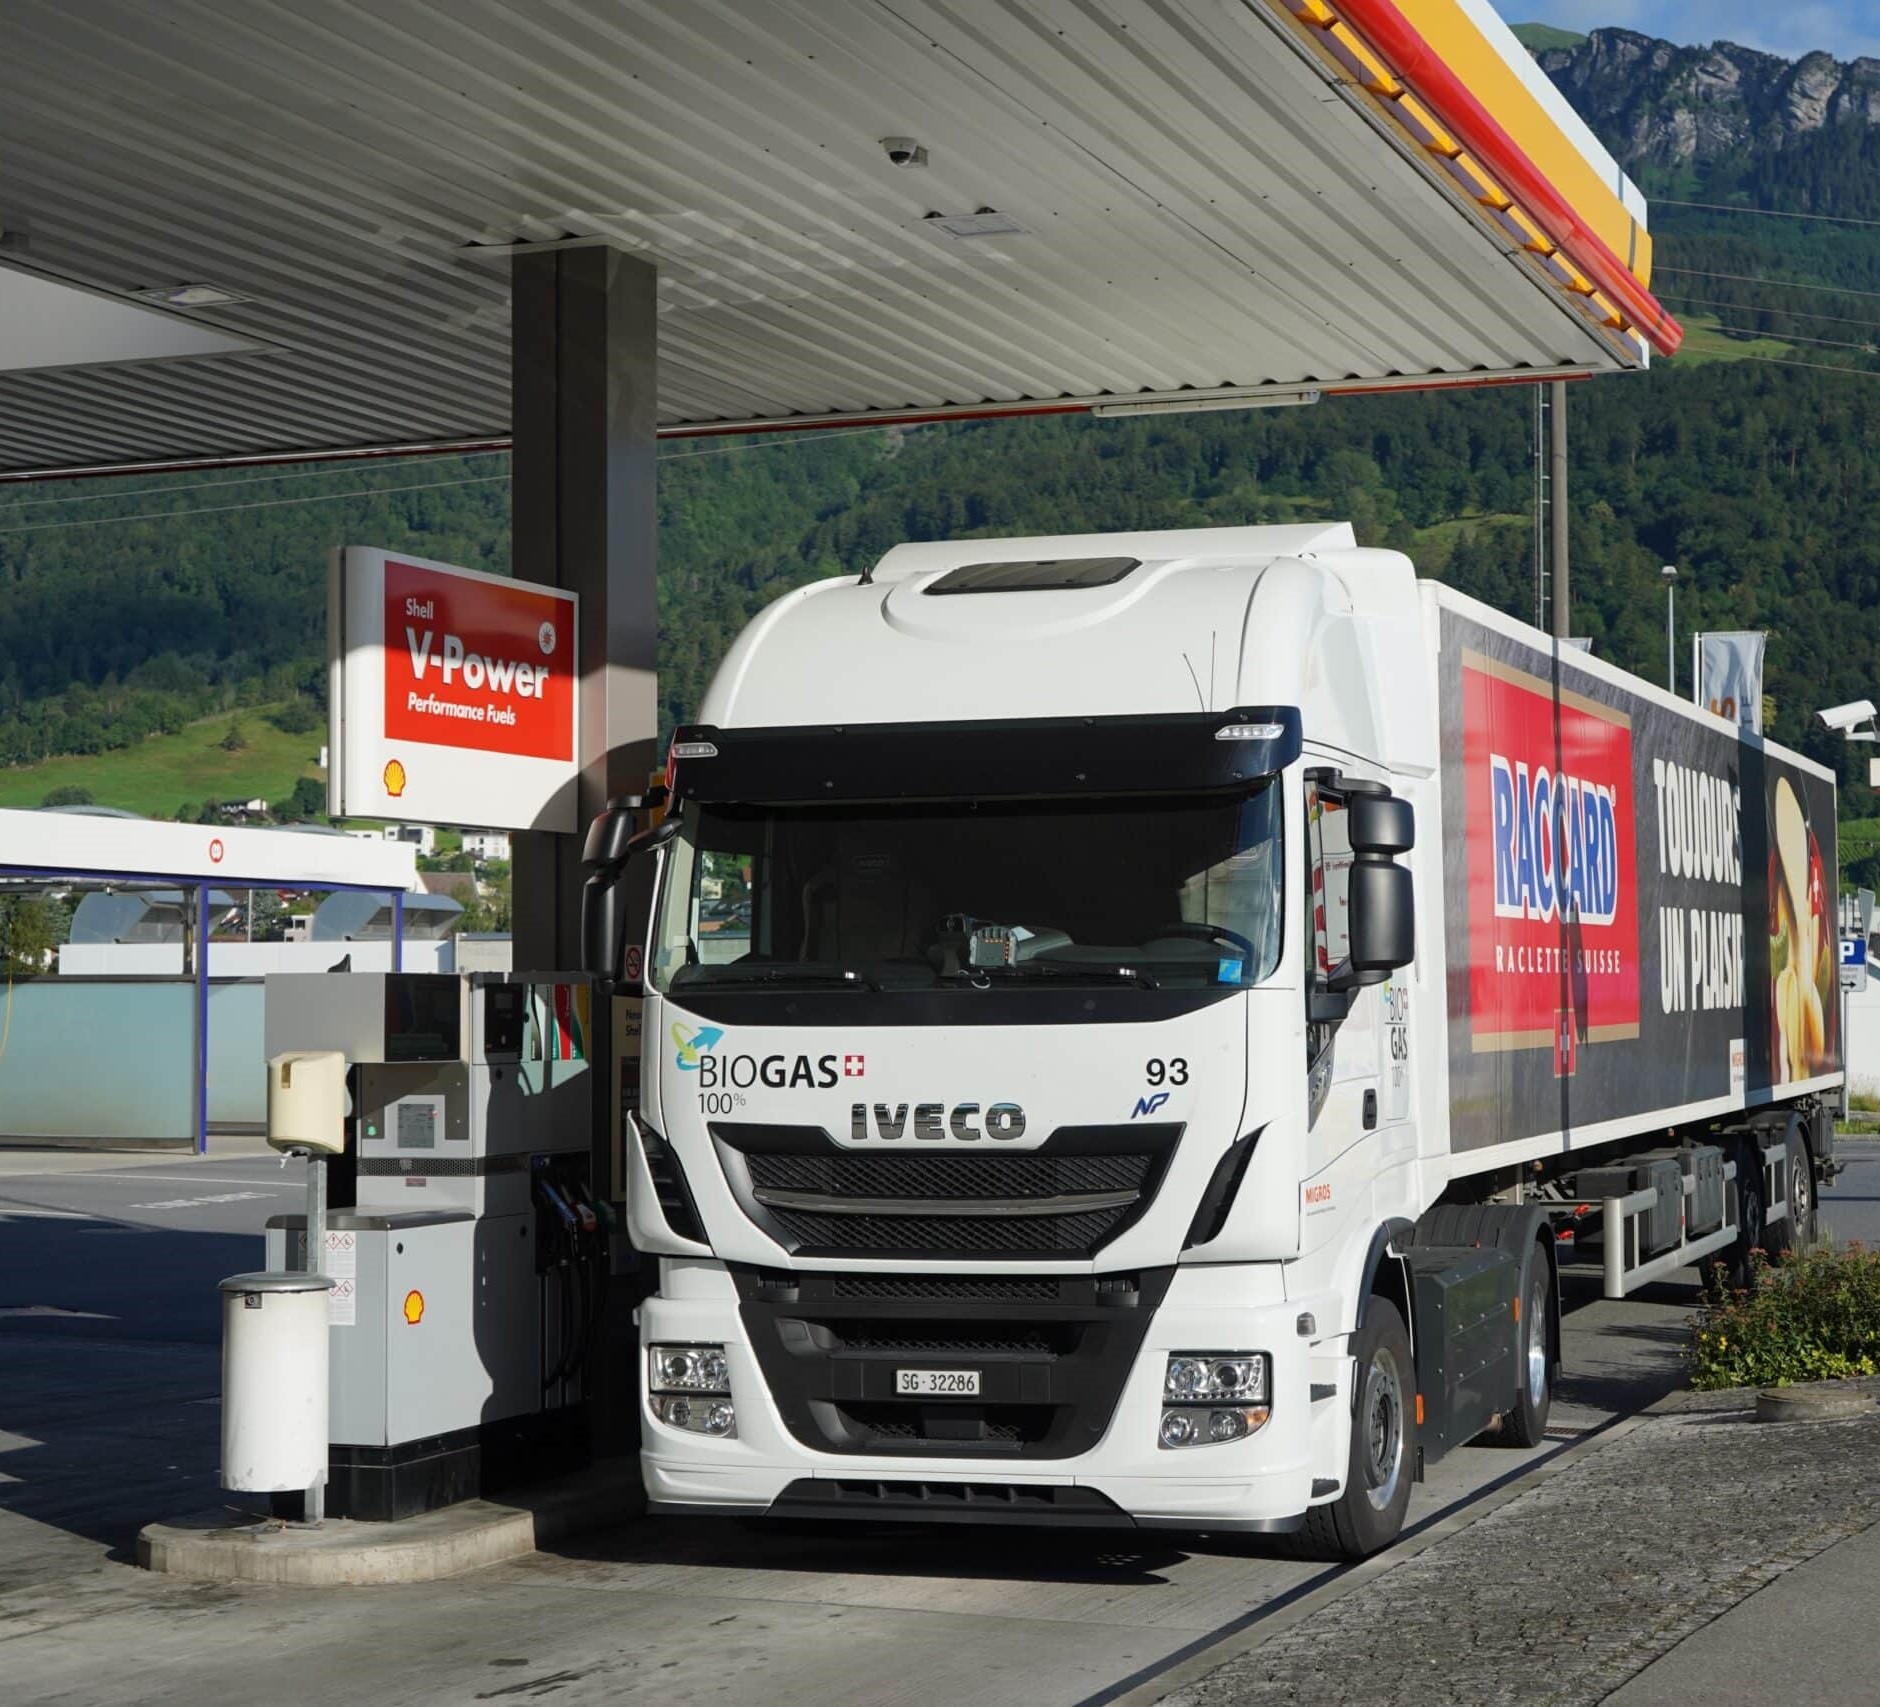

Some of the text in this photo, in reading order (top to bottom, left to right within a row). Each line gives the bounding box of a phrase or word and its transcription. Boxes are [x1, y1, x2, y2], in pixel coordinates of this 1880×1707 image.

[405, 598, 434, 619] Shell
[405, 627, 549, 699] V-Power
[407, 692, 516, 726] Performance Fuels
[1490, 753, 1618, 926] RACCARD
[1496, 945, 1621, 973] RACLETTE SUISSE
[1660, 907, 1686, 1014] UN
[1839, 941, 1855, 963] P
[1390, 987, 1404, 1021] BIO
[1391, 1027, 1408, 1060] GAS
[699, 1055, 839, 1088] BIOGAS
[1146, 1058, 1189, 1086] 93
[698, 1092, 746, 1114] 100%
[1130, 1092, 1170, 1119] NP
[851, 1102, 1026, 1140] IVECO
[1305, 1183, 1331, 1203] MIGROS
[929, 1374, 975, 1391] 32286
